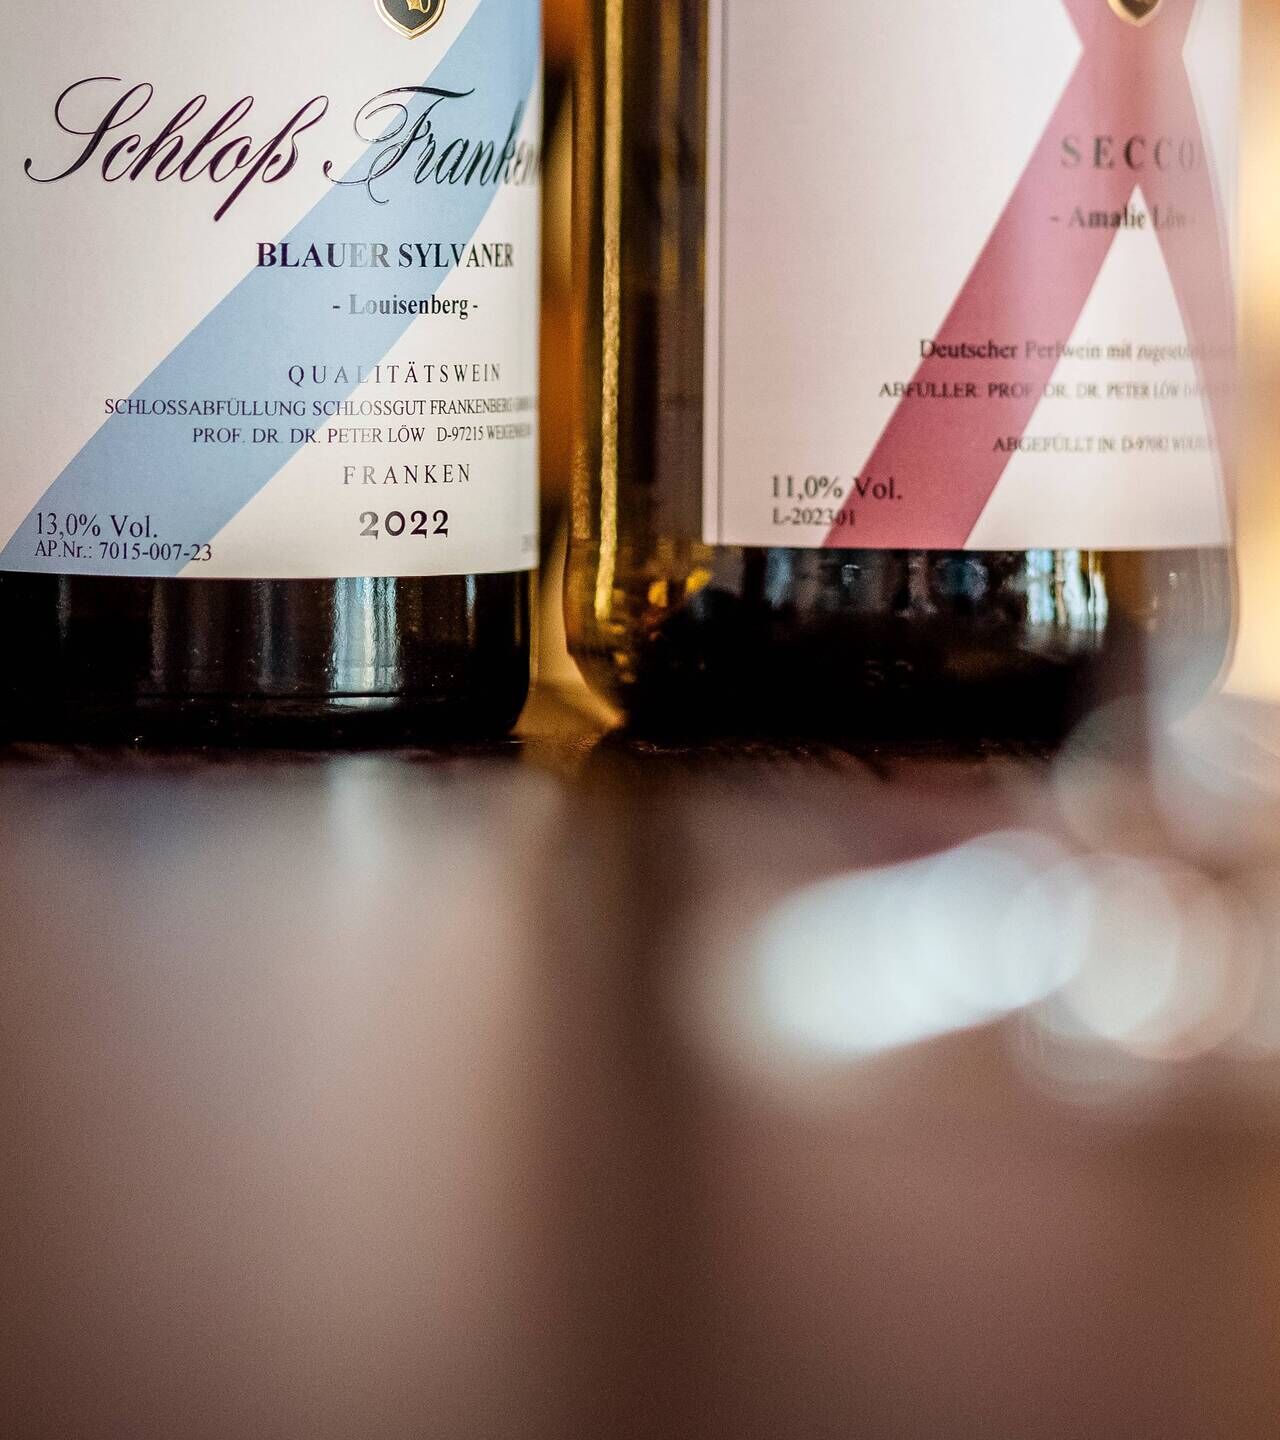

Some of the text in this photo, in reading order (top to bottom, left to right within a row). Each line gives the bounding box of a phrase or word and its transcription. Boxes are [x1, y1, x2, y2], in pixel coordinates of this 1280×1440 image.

[256, 242, 515, 268] BLAUER SYLVANER
[349, 293, 469, 321] Louisenberg
[919, 339, 1018, 360] Deutscher
[287, 361, 502, 388] QUALITÄTSWEIN
[104, 396, 306, 417] SCHLOSSABFÜLLUNG
[312, 399, 427, 417] SCHLOSSGUT
[430, 397, 513, 415] FRANKENBERG
[192, 427, 247, 444] PROF.
[290, 427, 321, 444] DR.
[327, 427, 384, 444] PETER
[387, 423, 426, 444] LÖW
[437, 426, 483, 442] D-97215
[342, 463, 471, 486] FRANKEN
[772, 475, 903, 501] 11,0% Vol.
[35, 512, 158, 541] 13,0% Vol.
[359, 508, 450, 541] 2022
[98, 541, 213, 562] 7015-007-23
